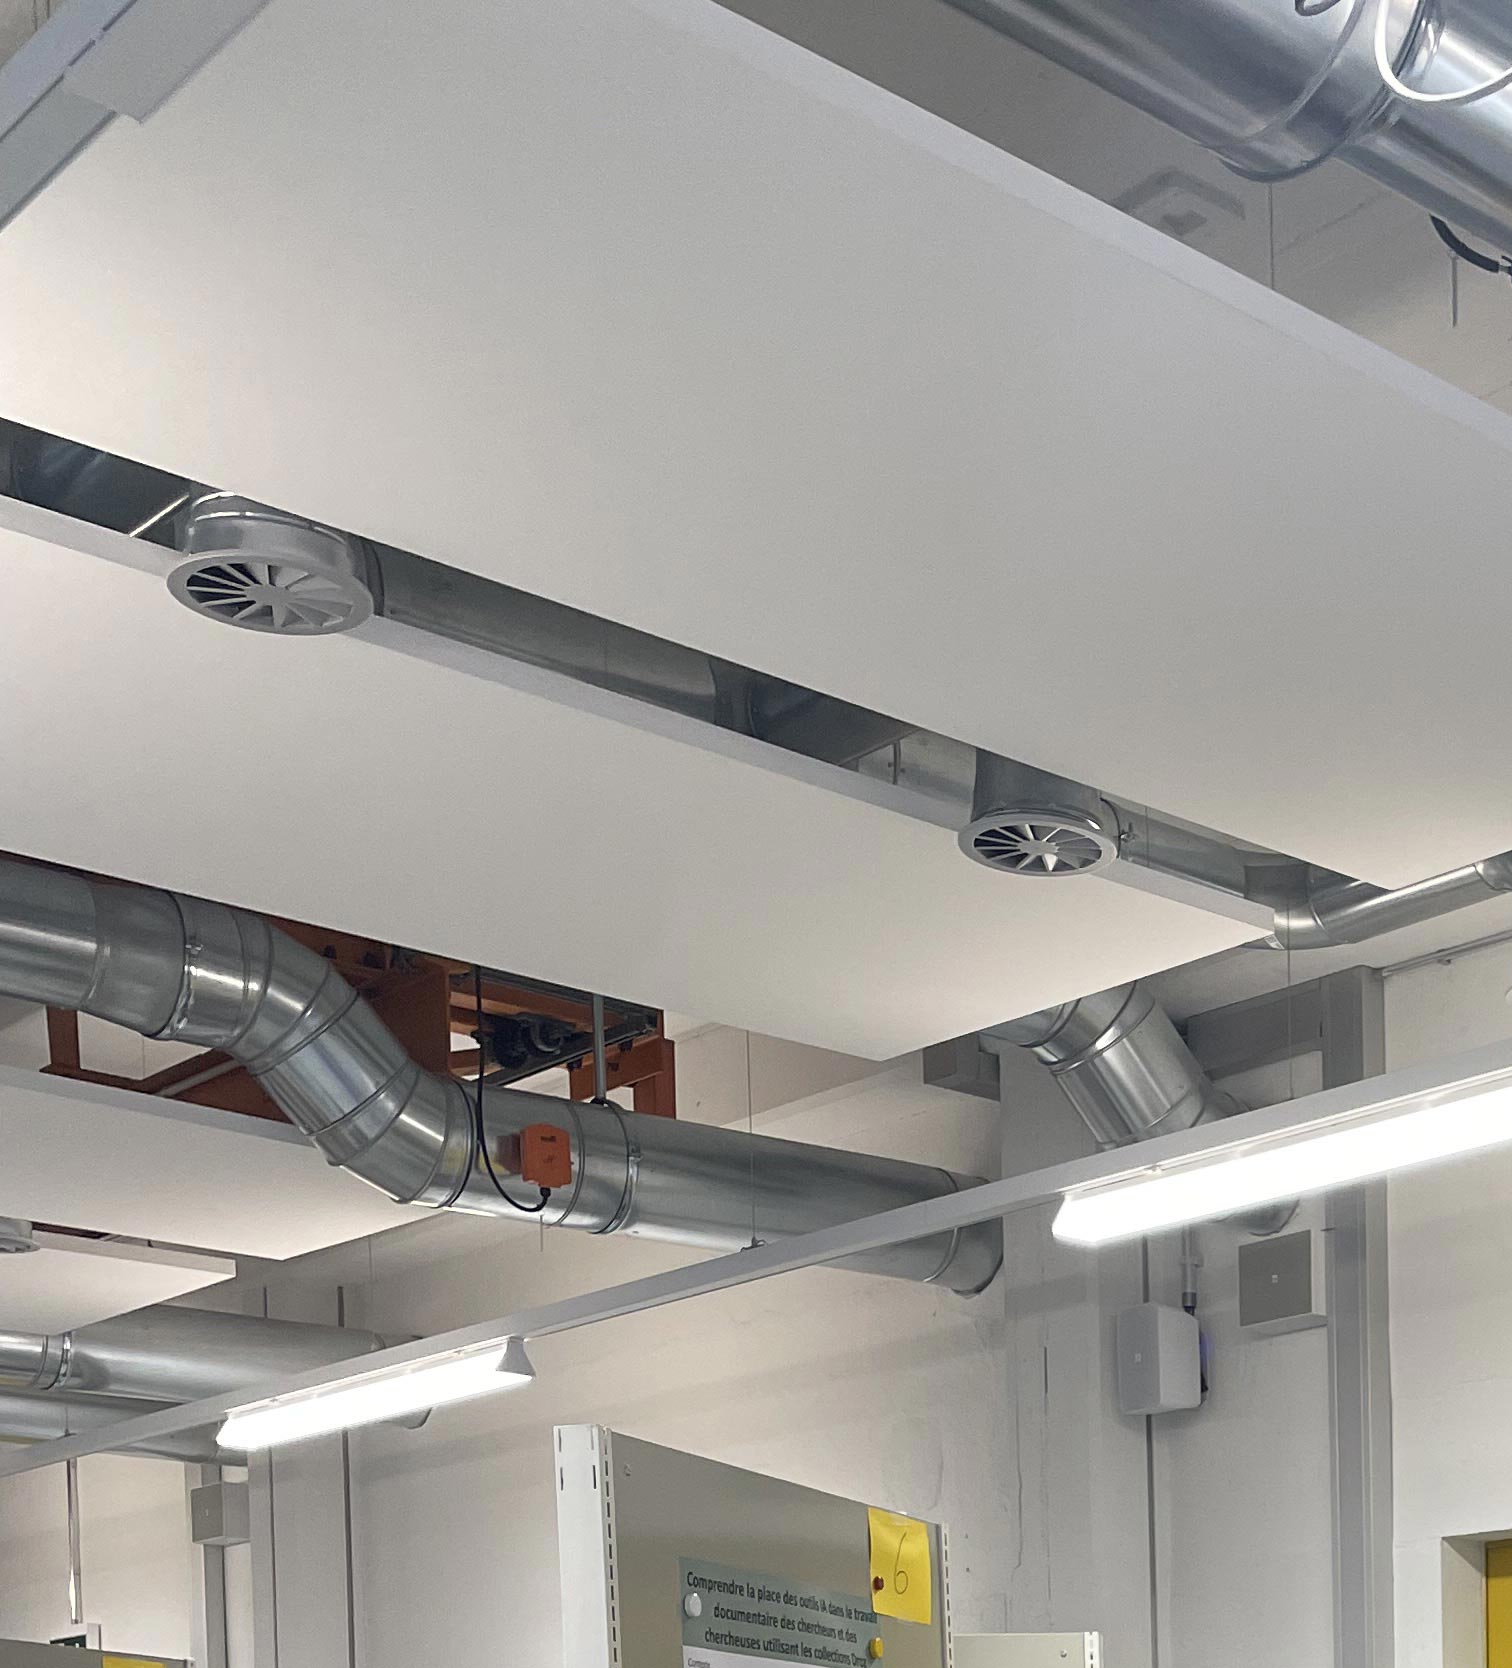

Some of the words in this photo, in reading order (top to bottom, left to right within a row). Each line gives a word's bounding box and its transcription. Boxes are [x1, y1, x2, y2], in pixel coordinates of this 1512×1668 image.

[894, 1531, 909, 1595] 6
[687, 1571, 745, 1597] Comprendre
[746, 1582, 756, 1599] la
[758, 1585, 782, 1603] place
[783, 1590, 798, 1607] des
[800, 1596, 820, 1612] outils
[829, 1600, 845, 1618] dans
[845, 1604, 853, 1620] le
[854, 1607, 877, 1624] travail
[713, 1602, 779, 1628] documentaire
[780, 1613, 796, 1631] des
[797, 1617, 837, 1639] chercheurs
[838, 1628, 845, 1641] et
[846, 1628, 858, 1643] des
[704, 1627, 761, 1650] chercheuses
[763, 1637, 799, 1657] utilisant
[801, 1641, 813, 1658] les
[814, 1645, 851, 1666] collections
